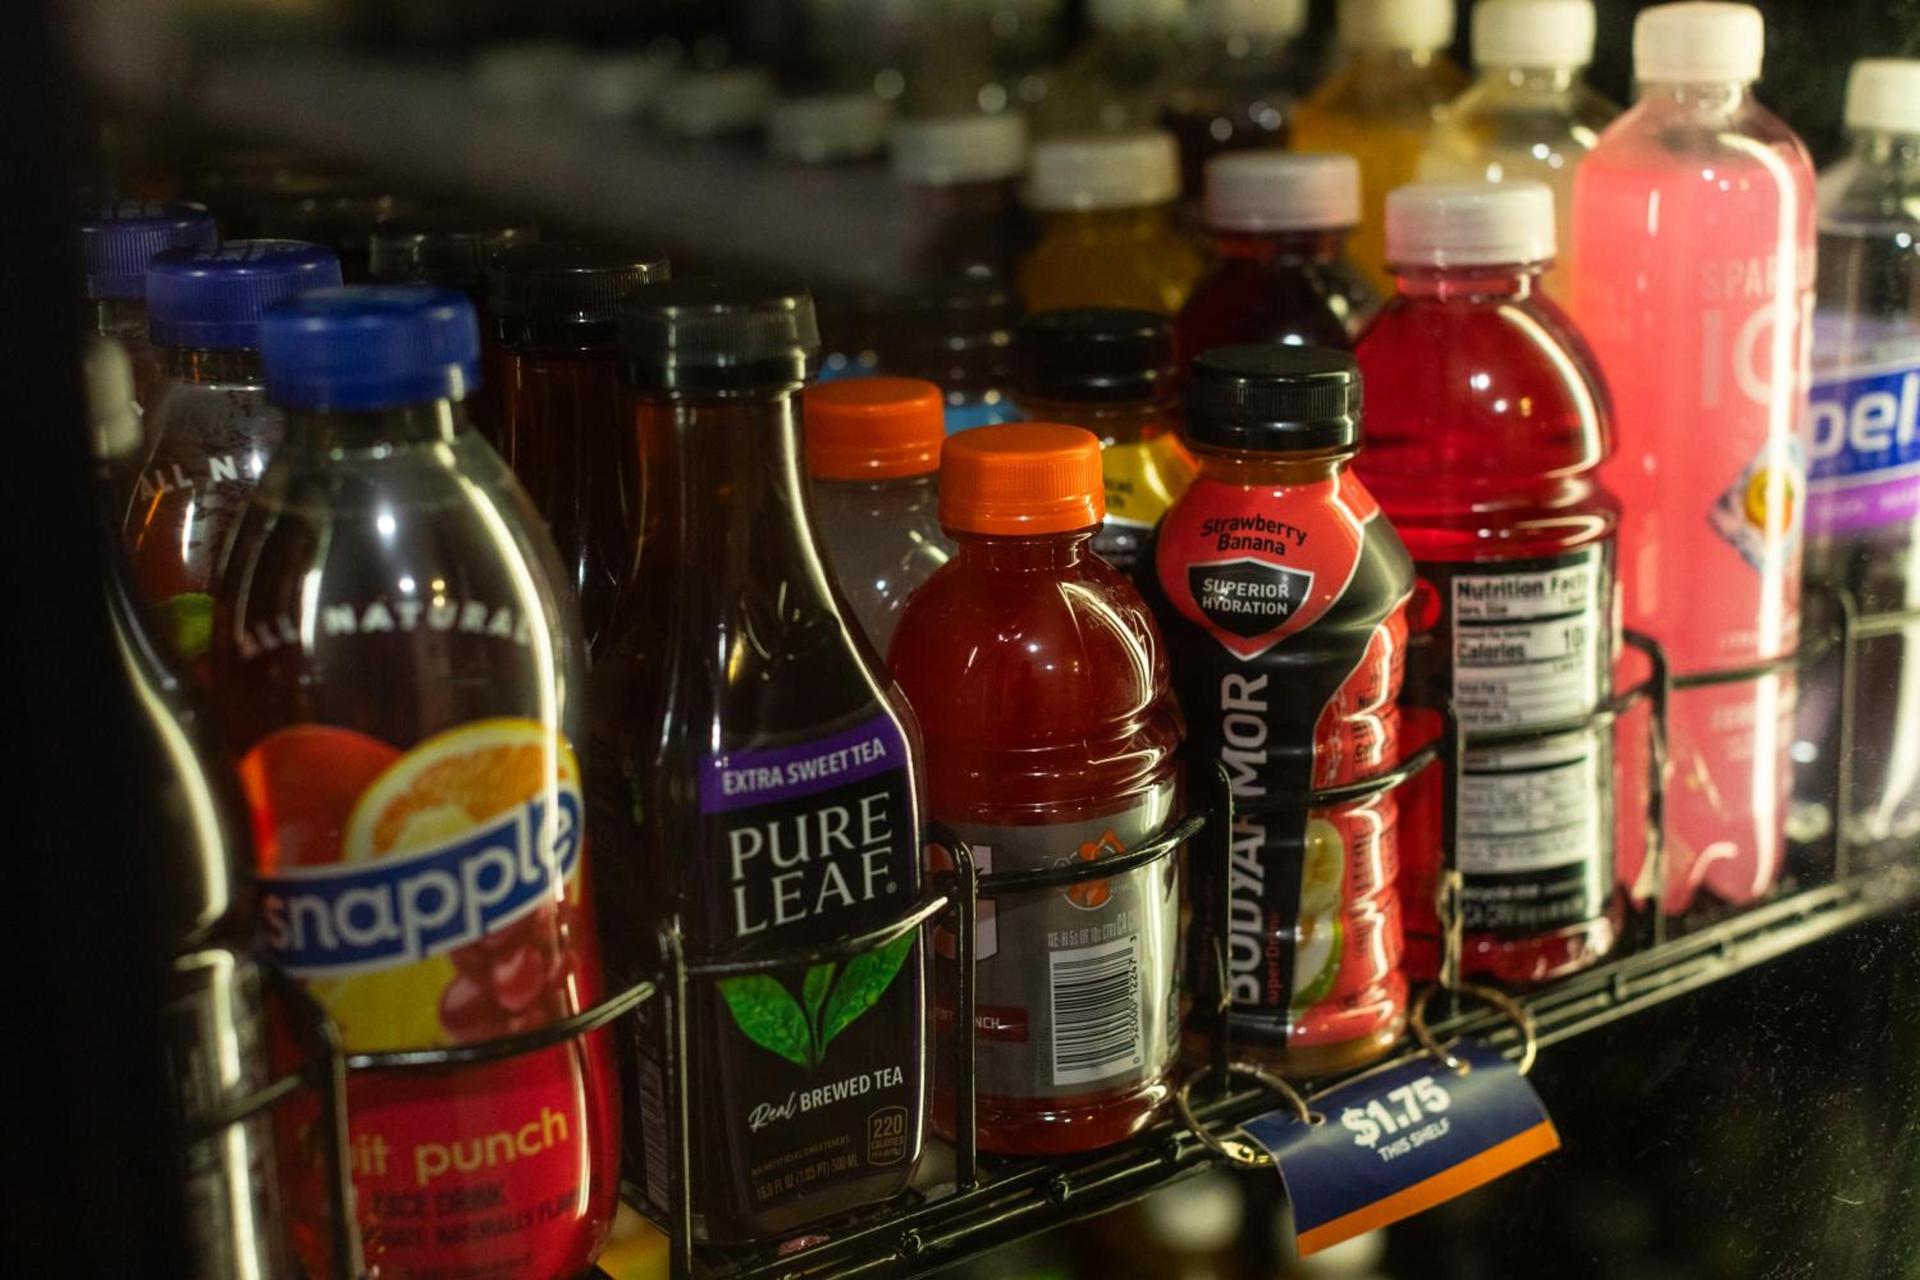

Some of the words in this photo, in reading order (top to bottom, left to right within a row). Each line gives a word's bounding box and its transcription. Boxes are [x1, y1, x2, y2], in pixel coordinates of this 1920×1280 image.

[1808, 371, 1919, 460] pel
[1201, 513, 1307, 547] Strawberry
[1217, 531, 1286, 556] Banana
[1202, 577, 1290, 598] SUPERIOR
[1202, 595, 1289, 616] HYDRATION
[1457, 578, 1544, 600] Nutrition
[321, 599, 531, 645] NATURAL
[722, 765, 785, 796] EXTRA
[786, 752, 850, 785] SWEET
[850, 737, 887, 766] TEA
[729, 792, 893, 882] PURE
[263, 804, 574, 959] snapple
[1128, 958, 1139, 997] 12247
[975, 1016, 1000, 1030] NCH
[1128, 1002, 1140, 1042] 52000
[748, 1091, 797, 1133] Real
[800, 1074, 871, 1112] BREWED
[873, 1065, 904, 1090] TEA
[1341, 1075, 1451, 1149] $1.75
[412, 1105, 569, 1188] punch
[873, 1113, 903, 1139] 220
[1377, 1137, 1412, 1162] THIS
[1409, 1117, 1450, 1148] SHELF
